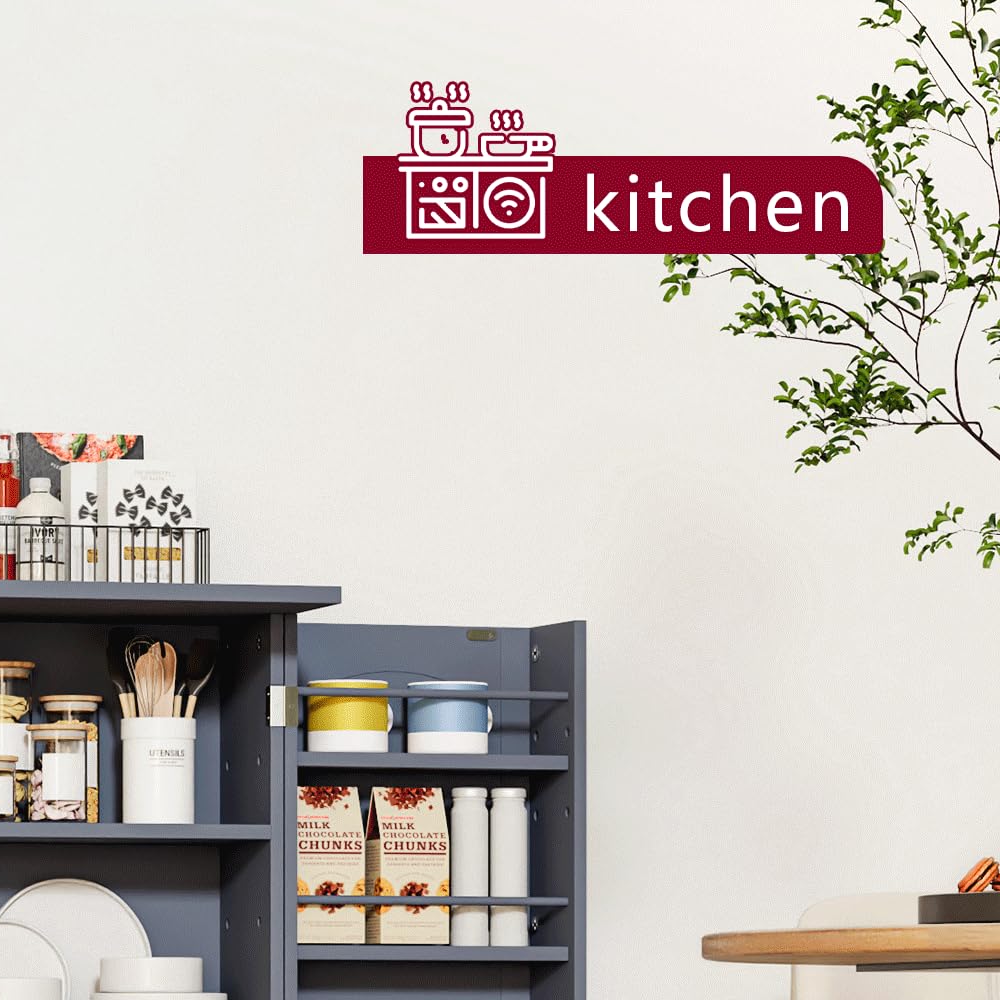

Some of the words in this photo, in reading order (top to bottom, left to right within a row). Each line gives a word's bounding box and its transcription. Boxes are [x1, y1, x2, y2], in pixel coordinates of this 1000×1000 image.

[149, 749, 185, 757] UTENSILS
[297, 821, 330, 829] MILK
[382, 822, 415, 830] MILK
[298, 840, 362, 850] CHUNKS
[383, 841, 447, 851] CHUNKS
